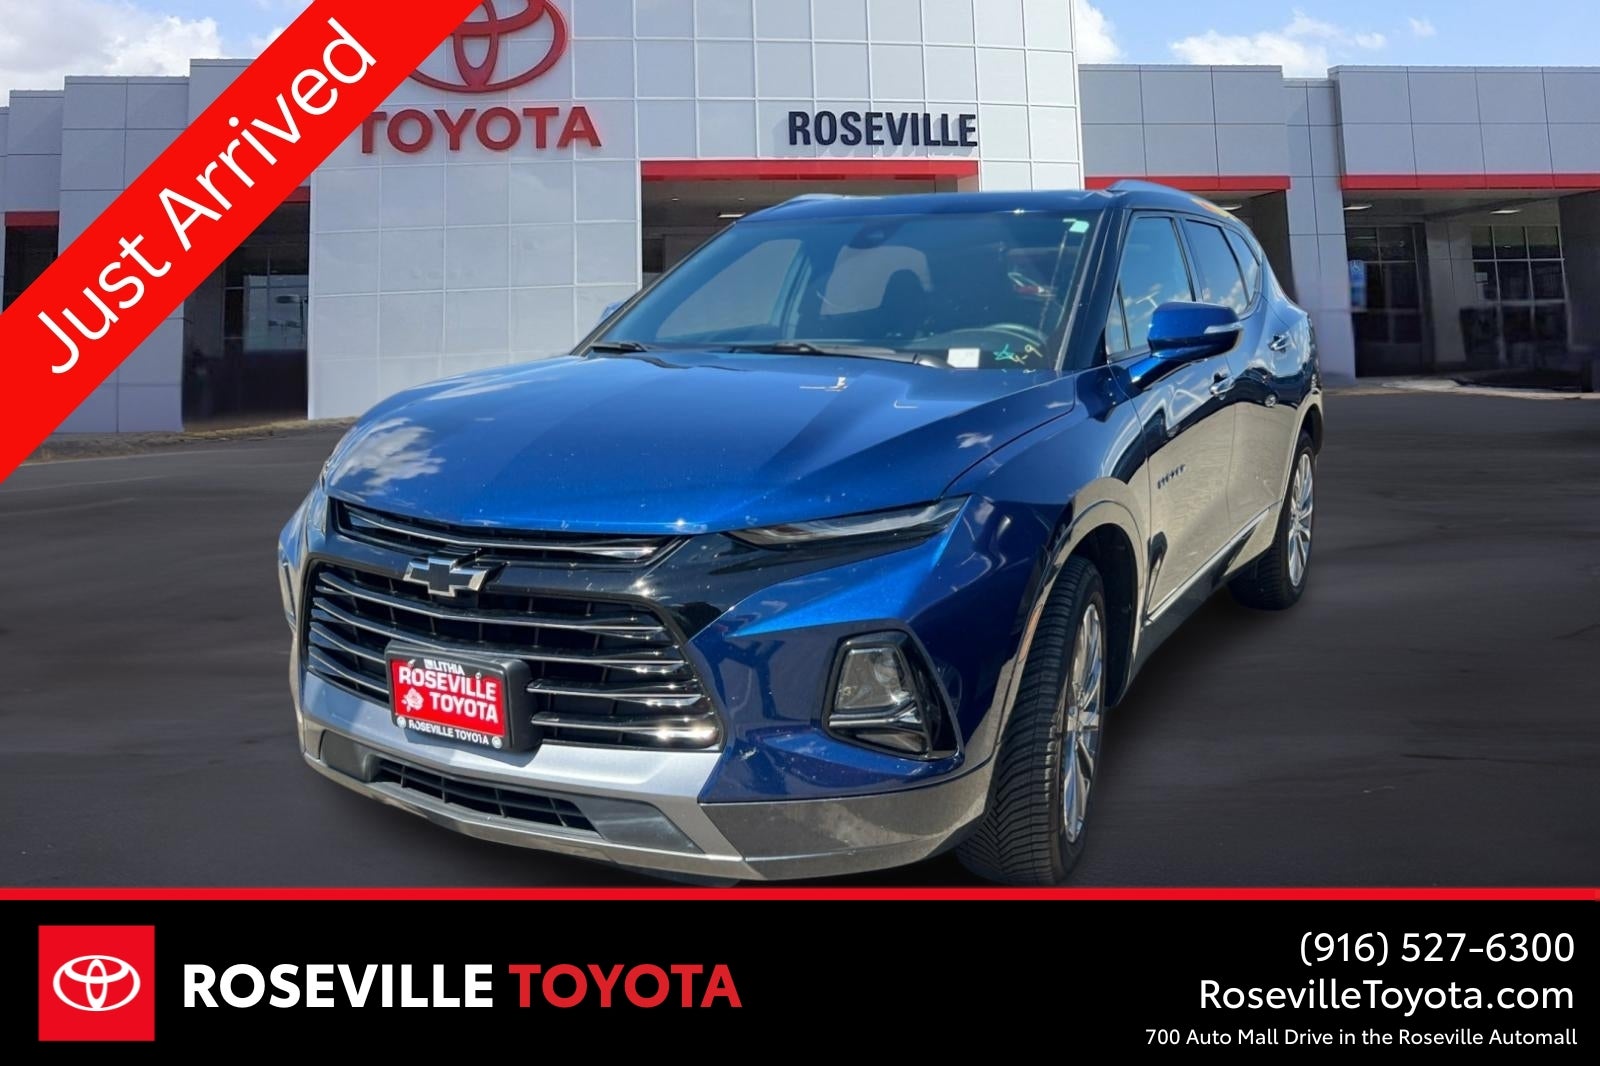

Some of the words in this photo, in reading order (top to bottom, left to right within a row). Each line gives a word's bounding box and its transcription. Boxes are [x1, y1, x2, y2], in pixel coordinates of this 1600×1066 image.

[361, 106, 602, 154] TOYOTA
[788, 110, 978, 147] ROSEVILLE
[398, 666, 497, 702] ROSEVILLE
[433, 660, 465, 676] LITHIA
[429, 692, 499, 724] TOYOTA
[408, 719, 455, 738] ROSEVILLE
[455, 728, 489, 746] TOYOTA
